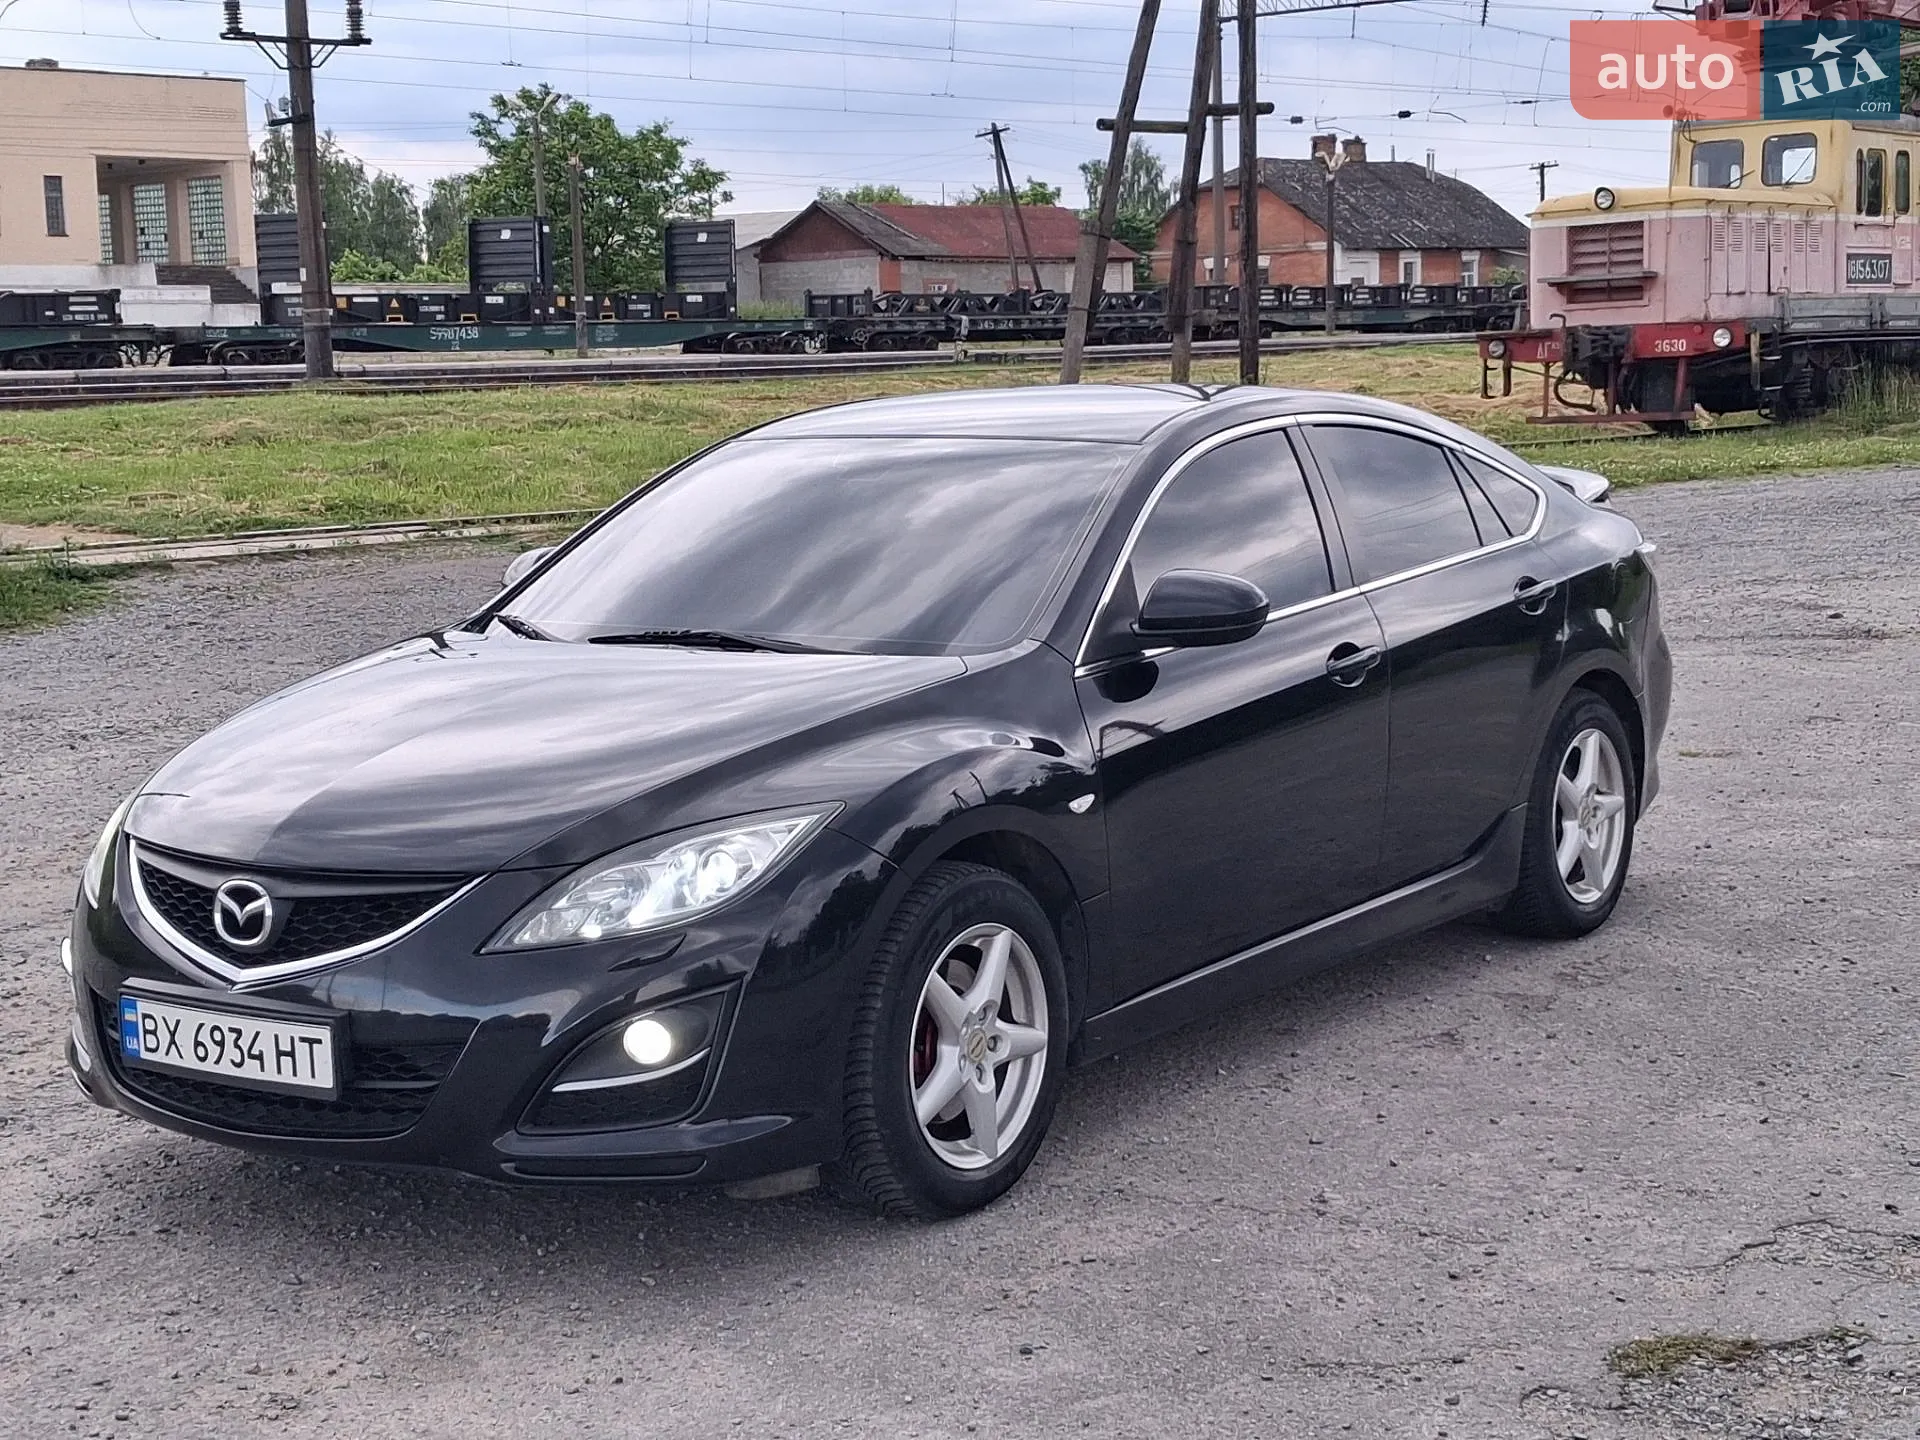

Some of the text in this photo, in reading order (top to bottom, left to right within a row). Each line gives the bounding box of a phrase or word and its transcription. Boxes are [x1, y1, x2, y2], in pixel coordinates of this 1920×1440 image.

[1654, 339, 1687, 353] 3630
[125, 1035, 139, 1050] UA
[141, 1012, 323, 1080] BX 6934 HT
